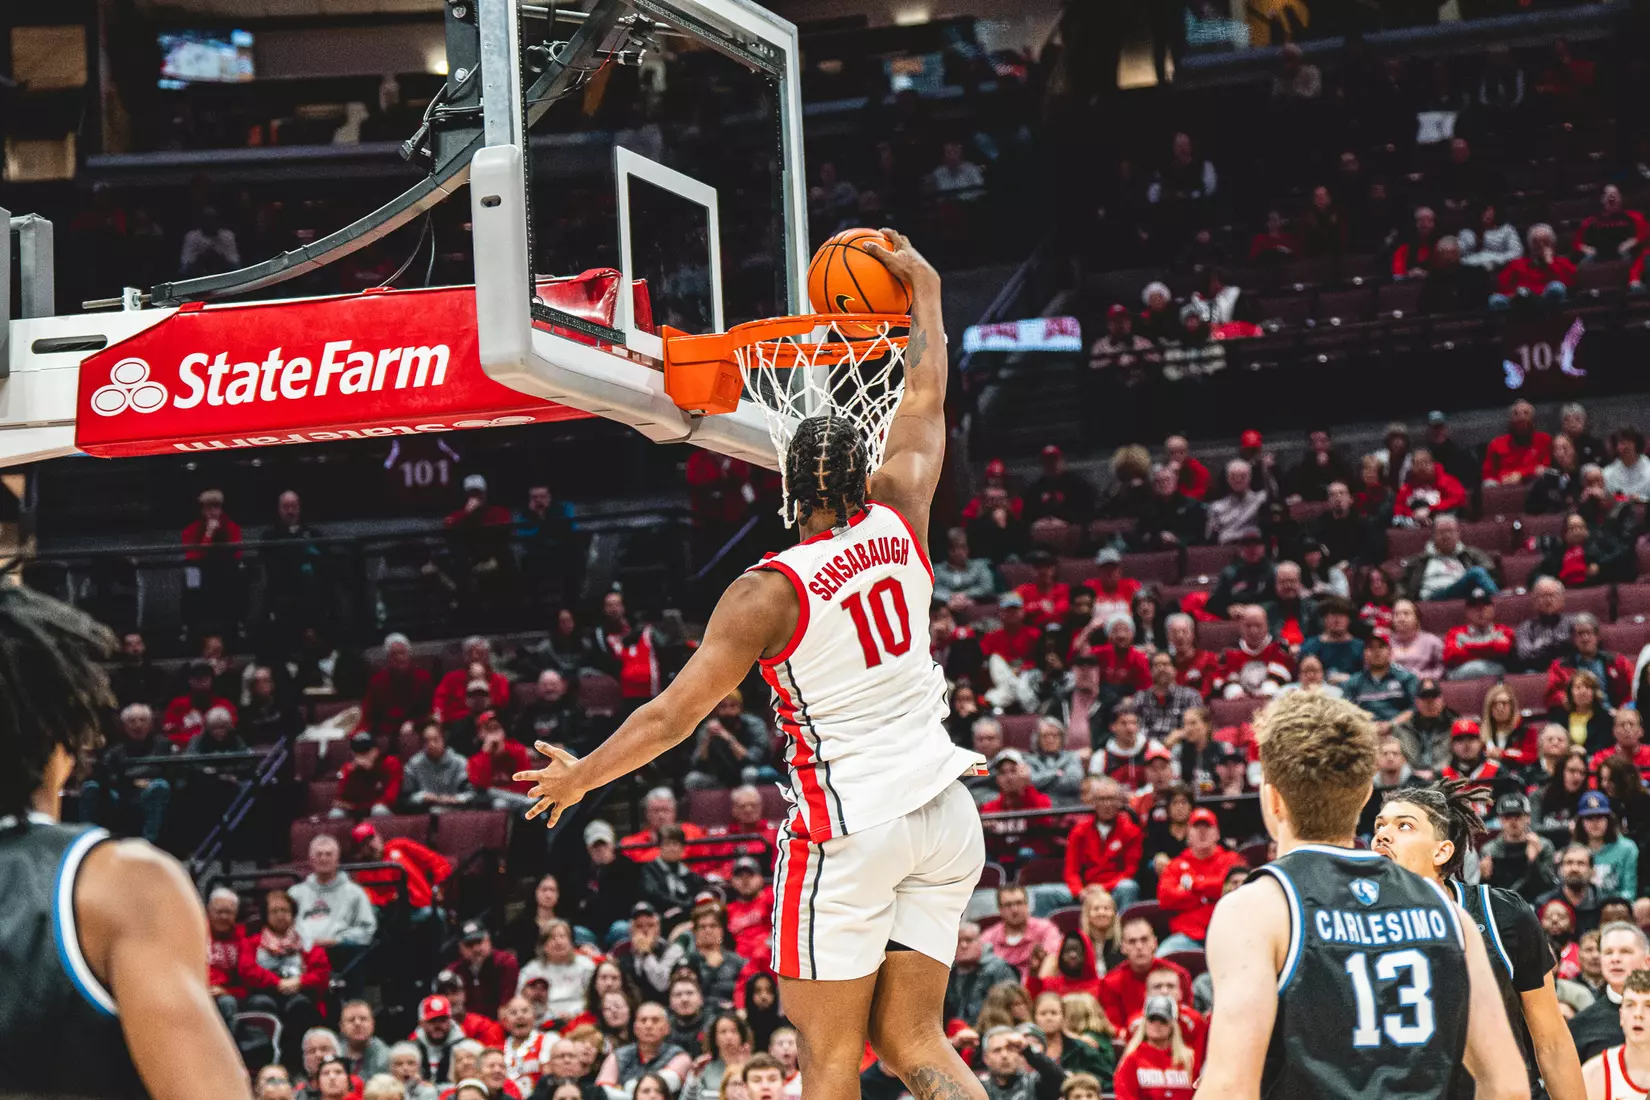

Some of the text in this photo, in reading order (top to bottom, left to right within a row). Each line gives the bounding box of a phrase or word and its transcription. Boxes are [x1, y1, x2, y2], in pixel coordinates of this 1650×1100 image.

[1514, 342, 1562, 372] 10
[400, 460, 448, 487] 101
[808, 537, 909, 601] SENSABAUGH
[840, 576, 911, 669] 10
[1315, 909, 1447, 944] CARLESIMO
[1345, 948, 1436, 1047] 13
